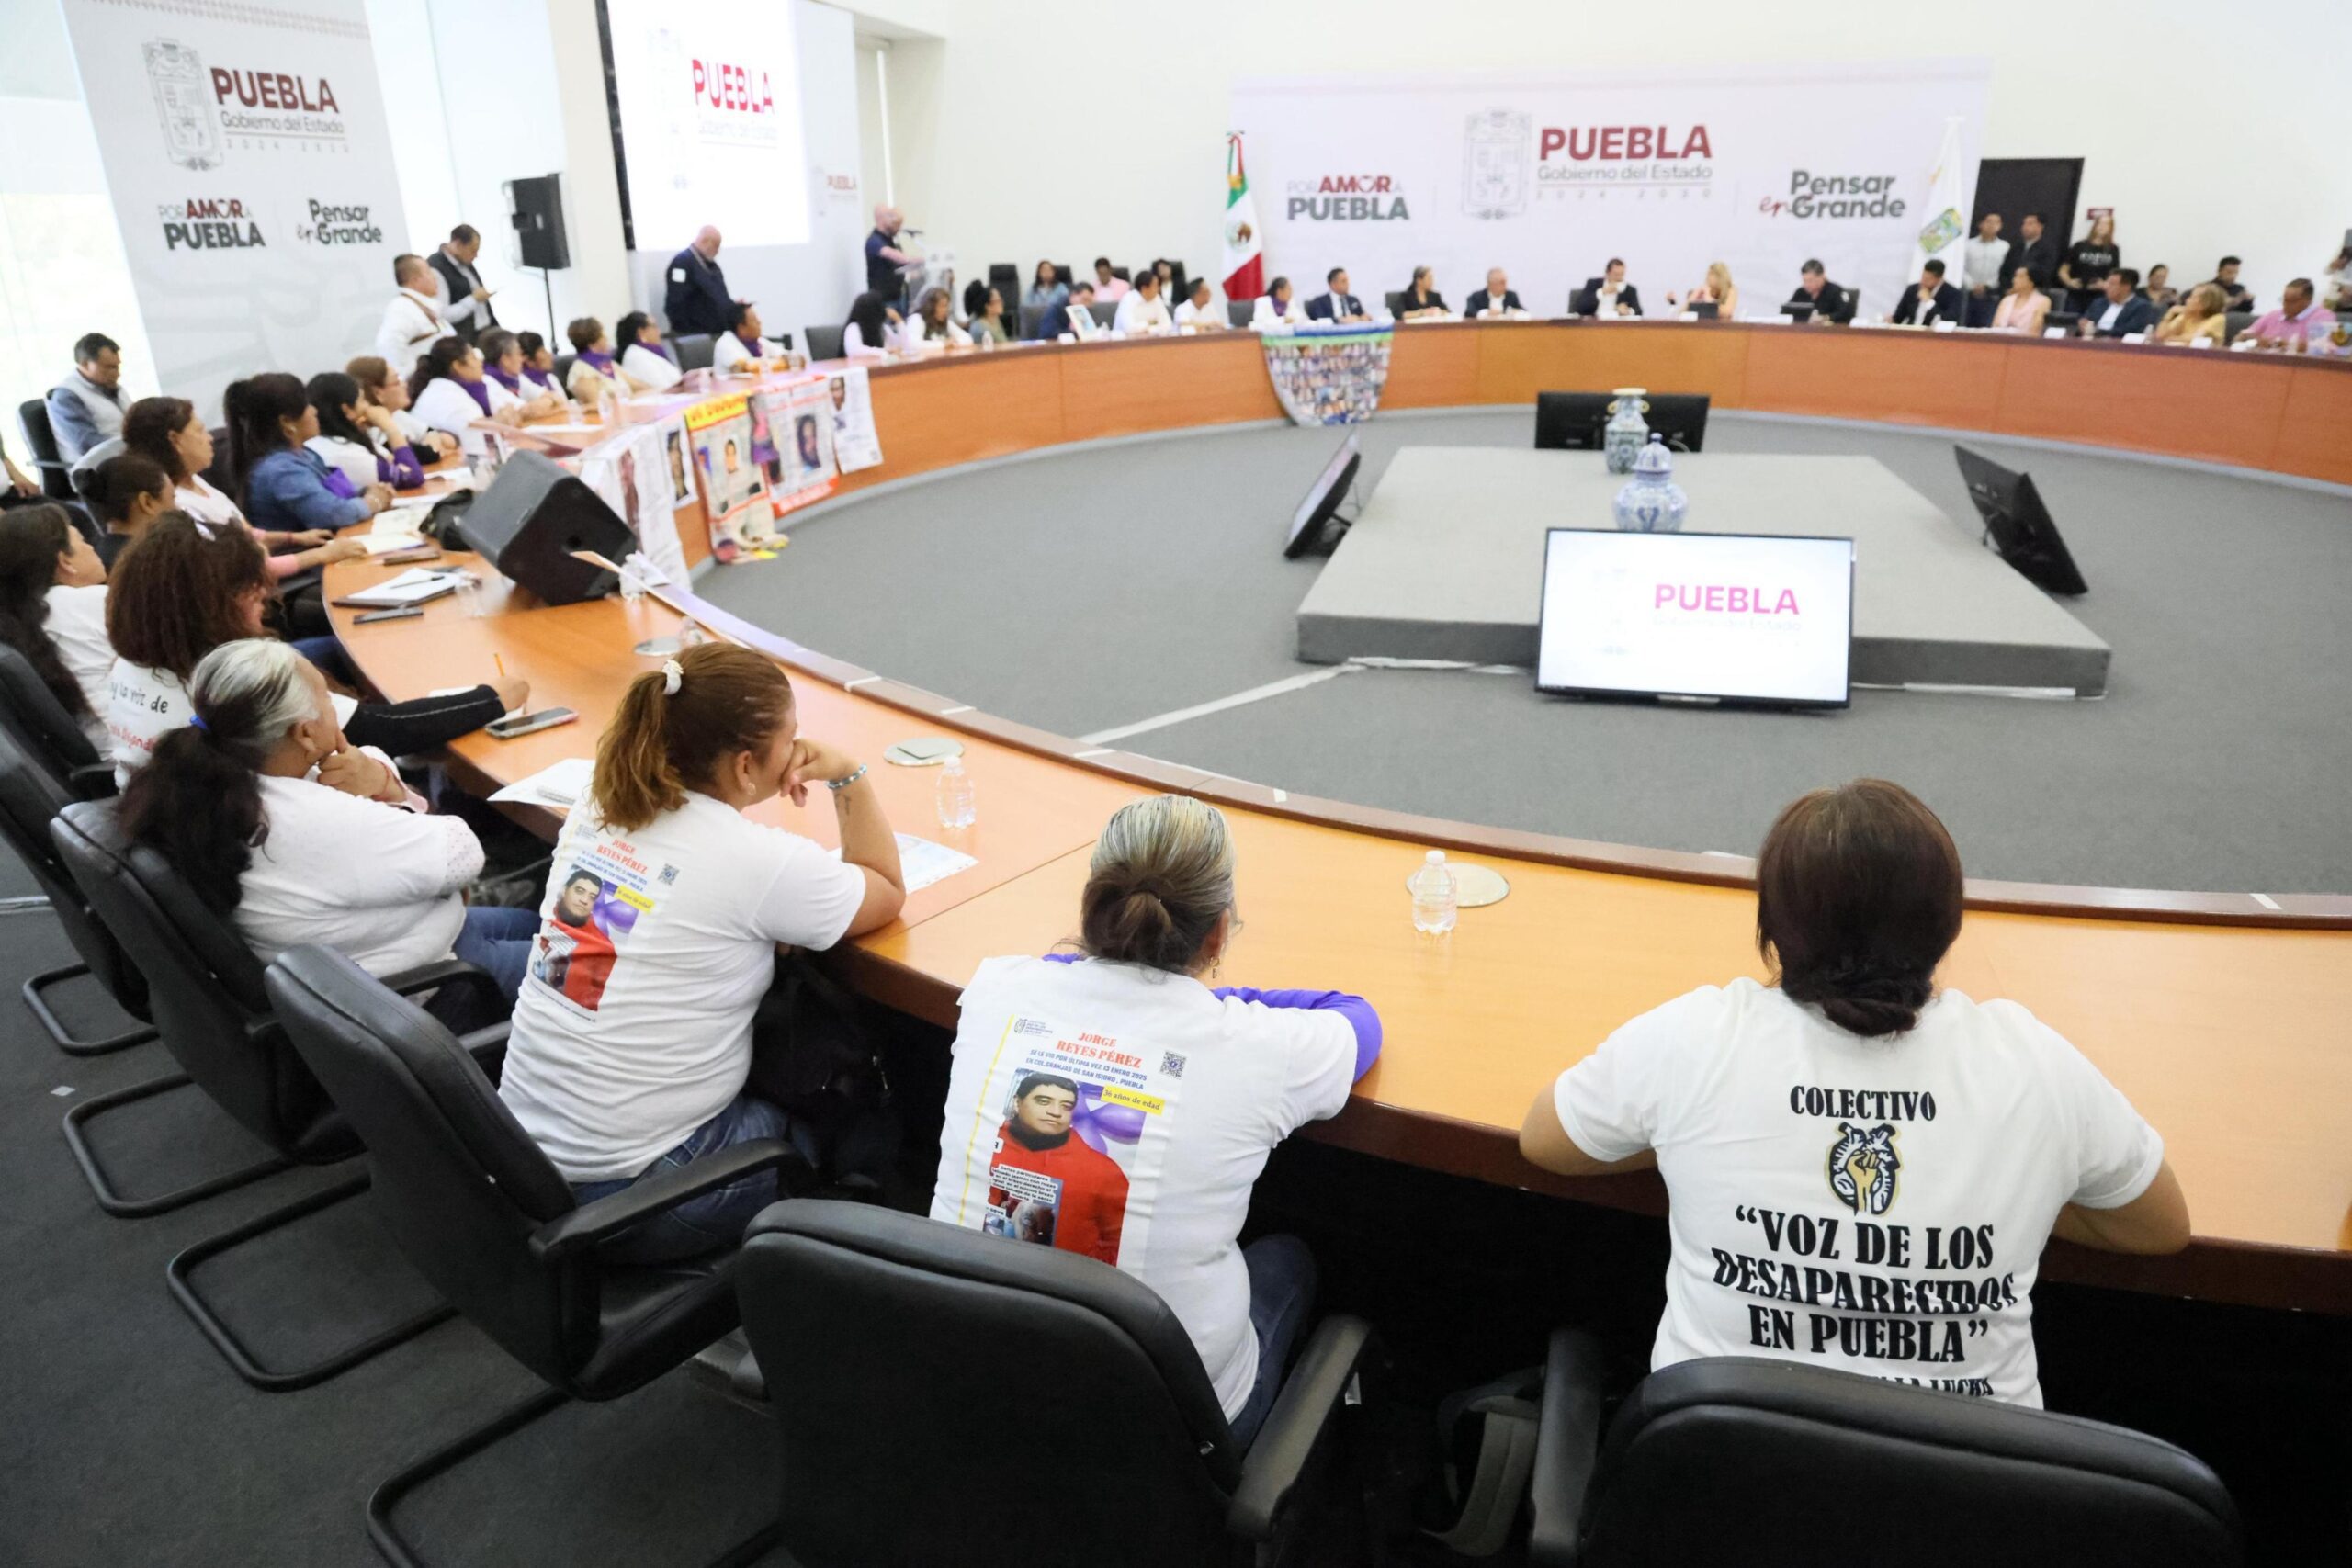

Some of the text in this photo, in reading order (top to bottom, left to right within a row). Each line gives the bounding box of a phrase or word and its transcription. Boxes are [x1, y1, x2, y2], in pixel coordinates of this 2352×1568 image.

[209, 67, 340, 114] PUEBLA
[692, 59, 775, 115] PUEBLA
[220, 110, 280, 131] Gobierno
[1539, 125, 1713, 162] PUEBLA
[1318, 175, 1392, 194] AMOR
[1537, 164, 1713, 182] Gobierno del Estado
[1790, 170, 1896, 196] Pensar
[186, 198, 244, 220] AMOR
[308, 198, 369, 223] Pensar
[1287, 197, 1410, 221] PUEBLA
[1792, 194, 1906, 219] Grande
[163, 221, 266, 250] PUEBLA
[316, 222, 383, 245] Grande
[1654, 583, 1801, 615] PUEBLA
[150, 695, 169, 714] de
[1078, 1032, 1117, 1048] JORGE
[1056, 1040, 1144, 1069] REYES PÉREZ
[1114, 1092, 1131, 1101] años
[1131, 1096, 1141, 1105] de
[1142, 1100, 1160, 1111] edad
[1789, 1085, 1937, 1122] COLECTIVO
[1735, 1204, 1995, 1270] “VOZ DE LOS
[1711, 1247, 2018, 1315] DESAPARECIDOS
[1747, 1303, 1989, 1363] EN PUEBLA”
